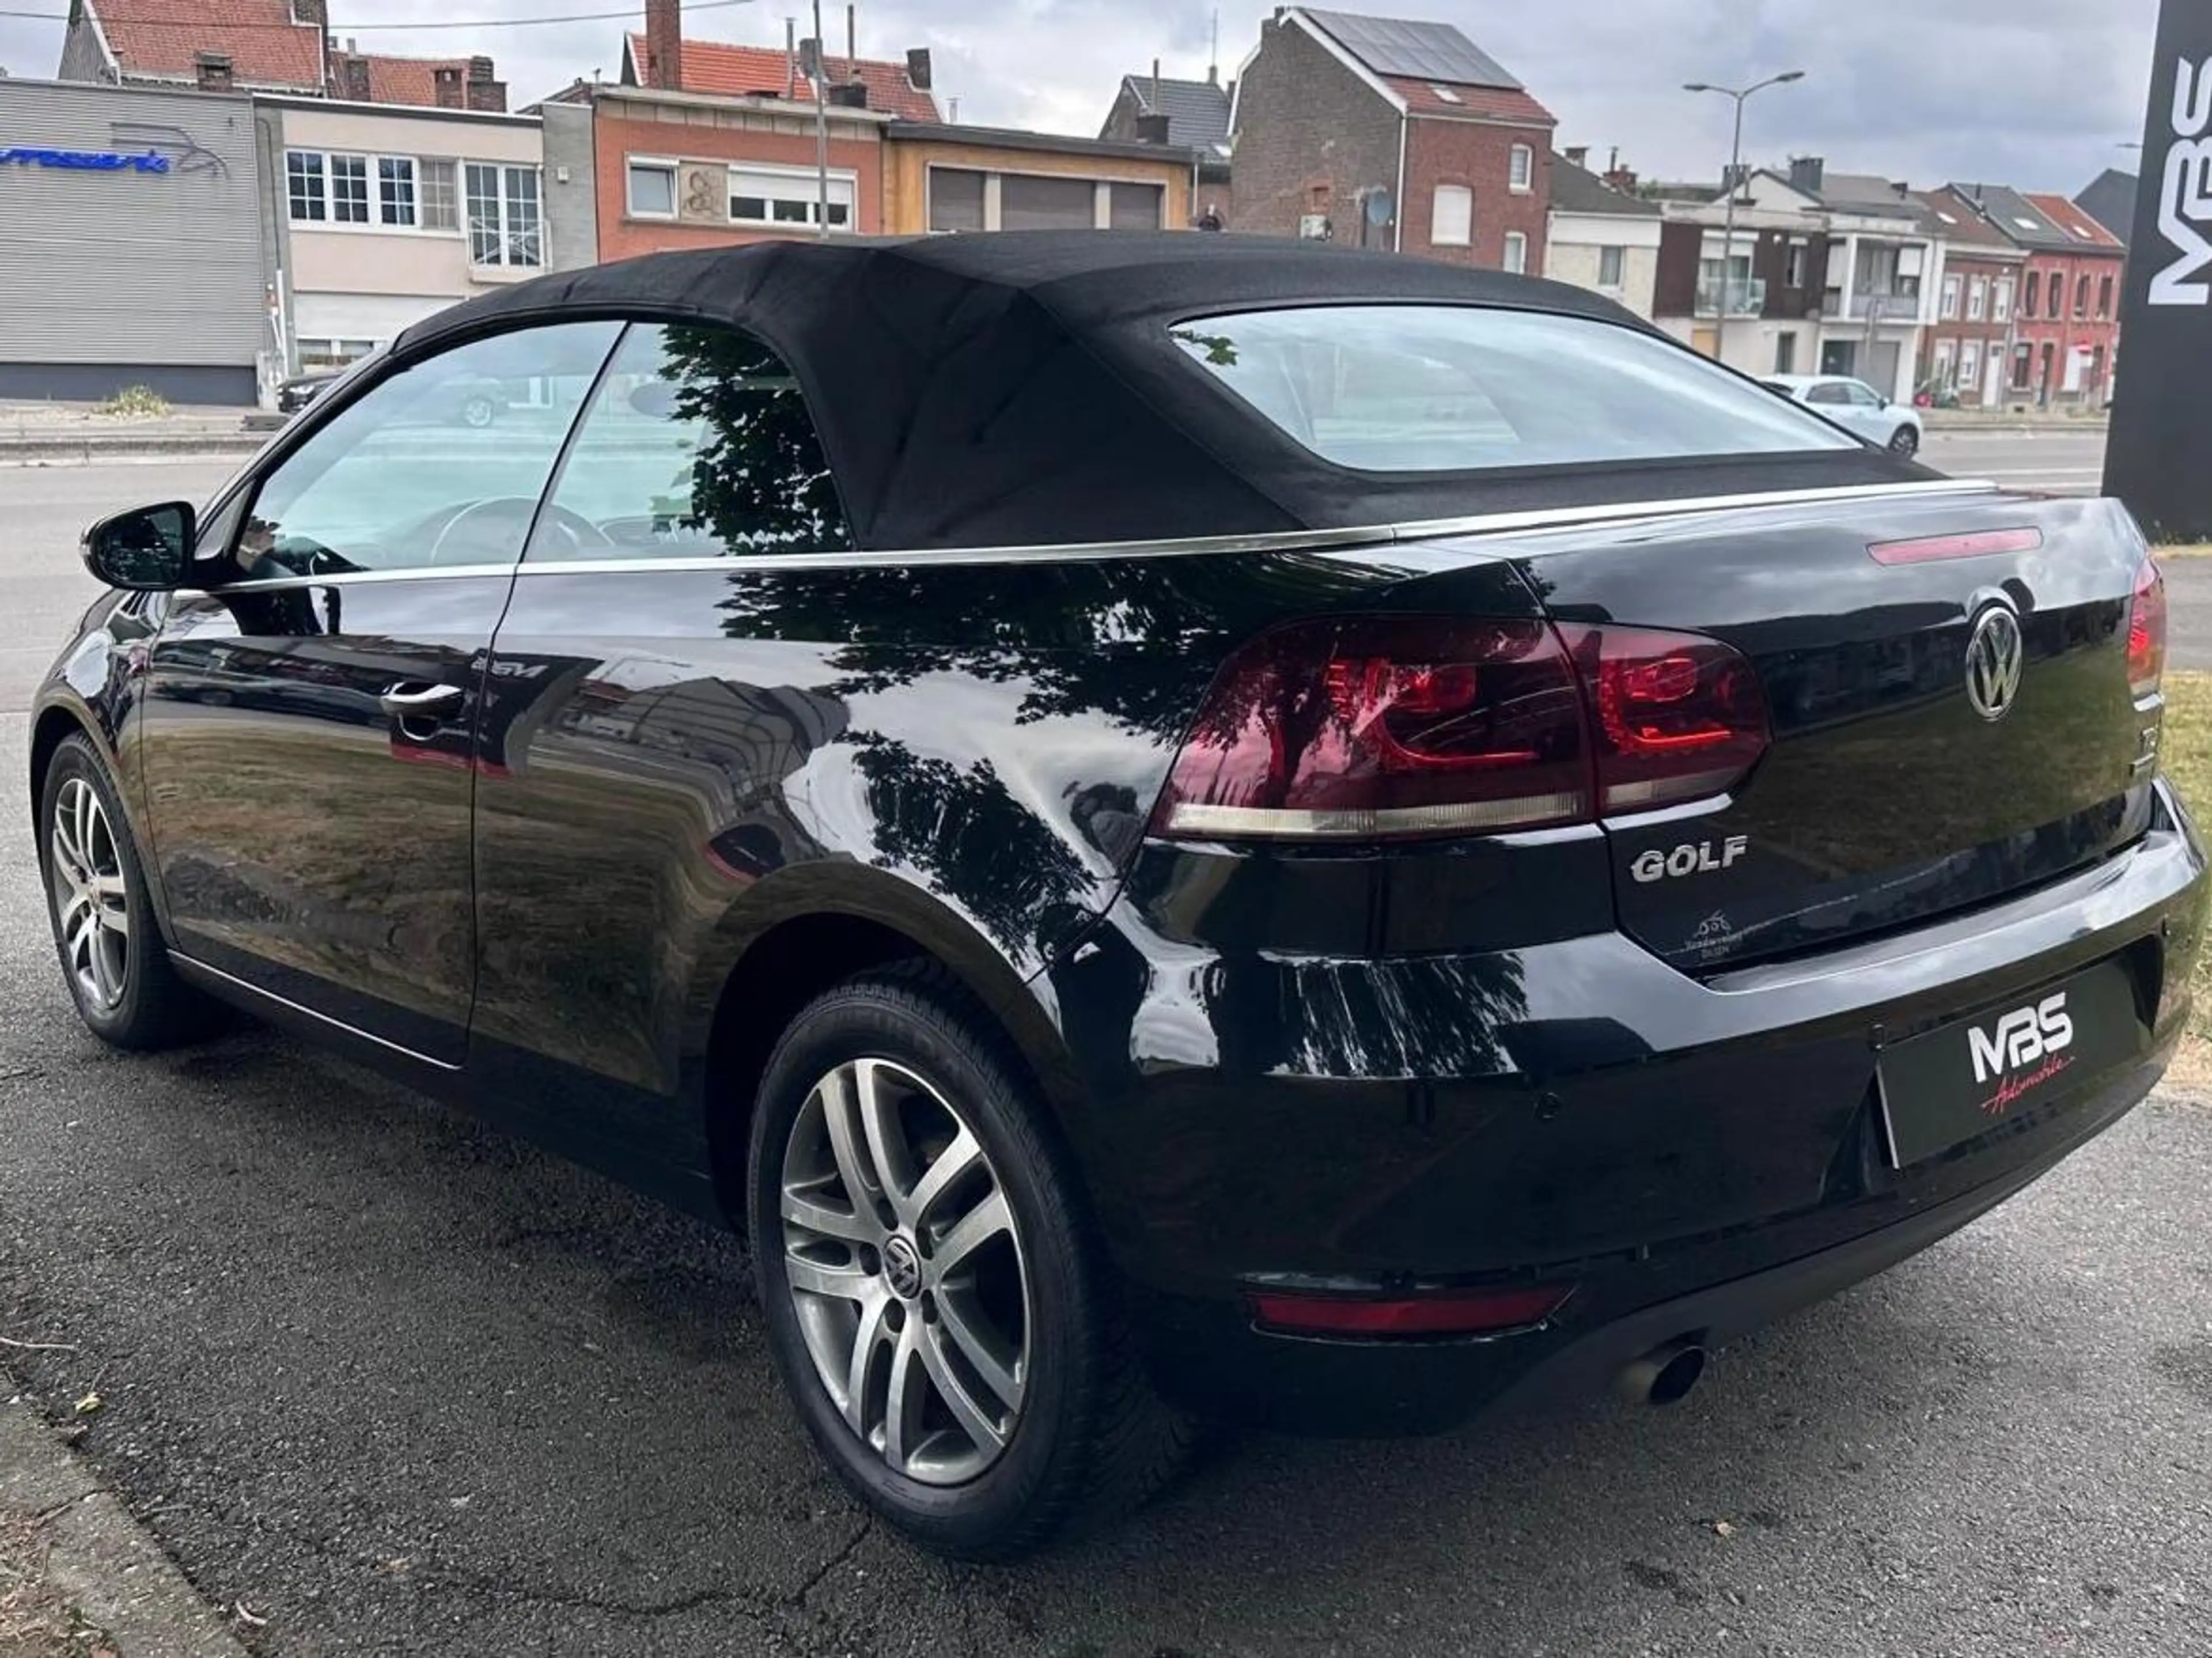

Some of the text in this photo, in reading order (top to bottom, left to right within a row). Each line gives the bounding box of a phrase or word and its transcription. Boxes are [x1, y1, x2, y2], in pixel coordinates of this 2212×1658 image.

[1966, 607, 2022, 718] VW
[1631, 835, 1748, 882] GOLF
[1968, 991, 2073, 1083] MBS
